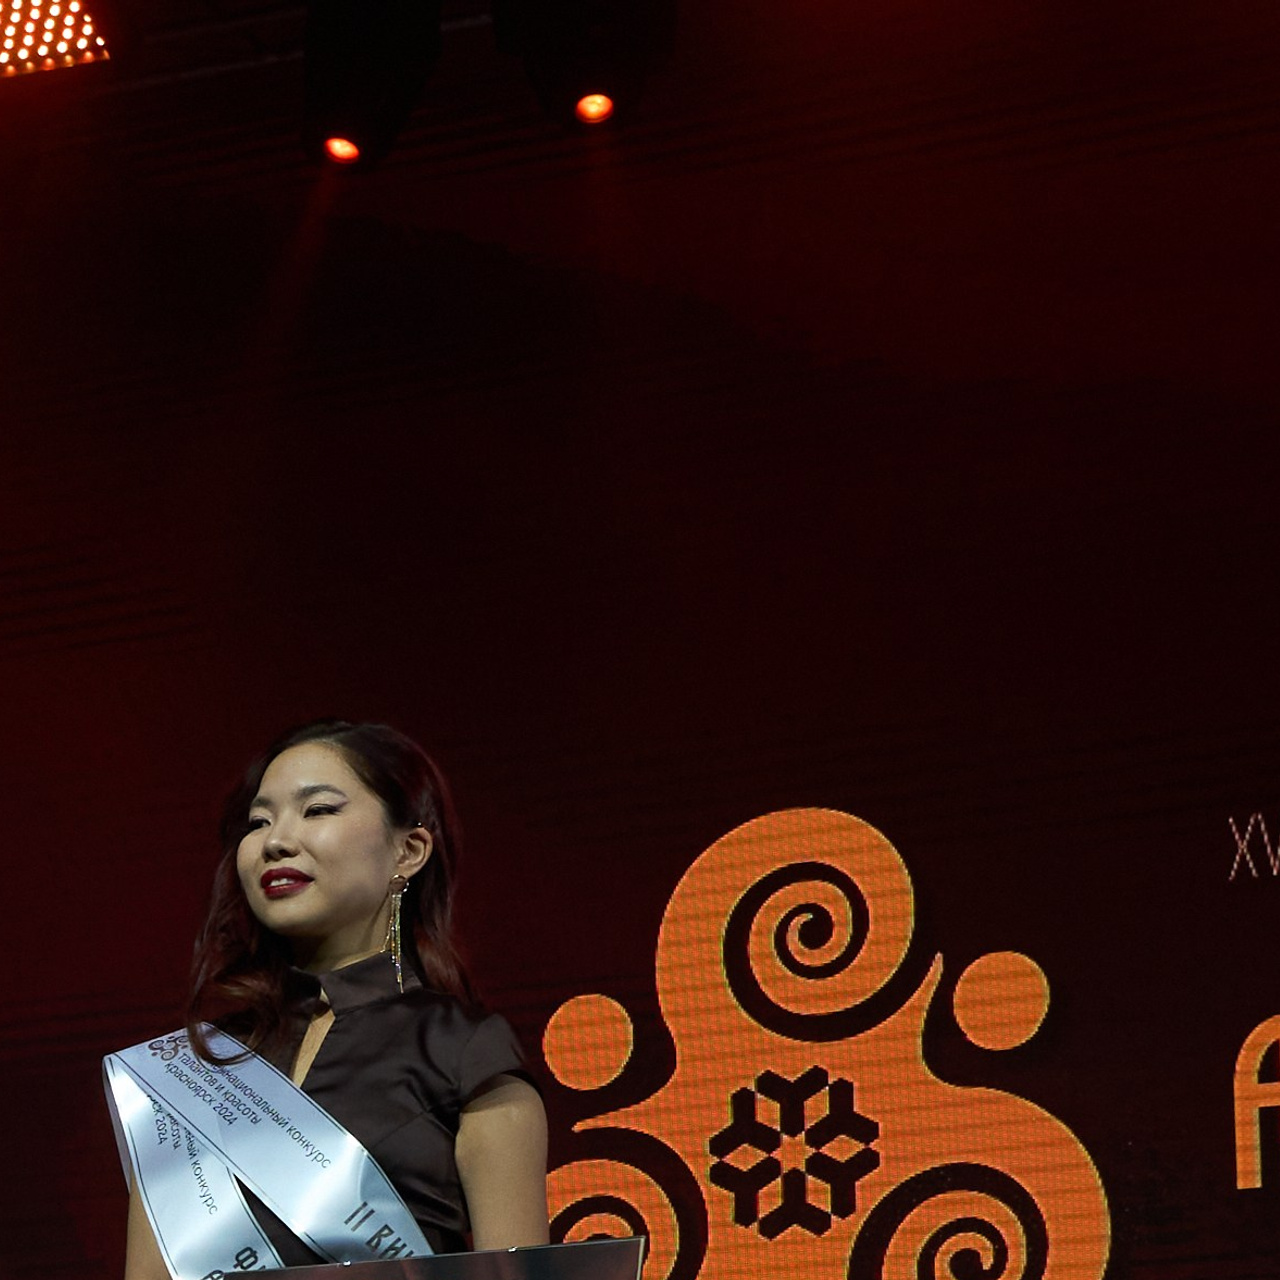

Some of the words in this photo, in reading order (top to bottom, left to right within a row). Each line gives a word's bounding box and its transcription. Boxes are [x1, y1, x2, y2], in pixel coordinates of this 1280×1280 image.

[163, 1062, 217, 1107] красноярск
[213, 1102, 239, 1127] 2024
[177, 1052, 221, 1087] талантов
[221, 1089, 263, 1126] красоты
[154, 1116, 169, 1145] 2024
[286, 1125, 332, 1169] конкурс
[190, 1159, 219, 1215] конкурс
